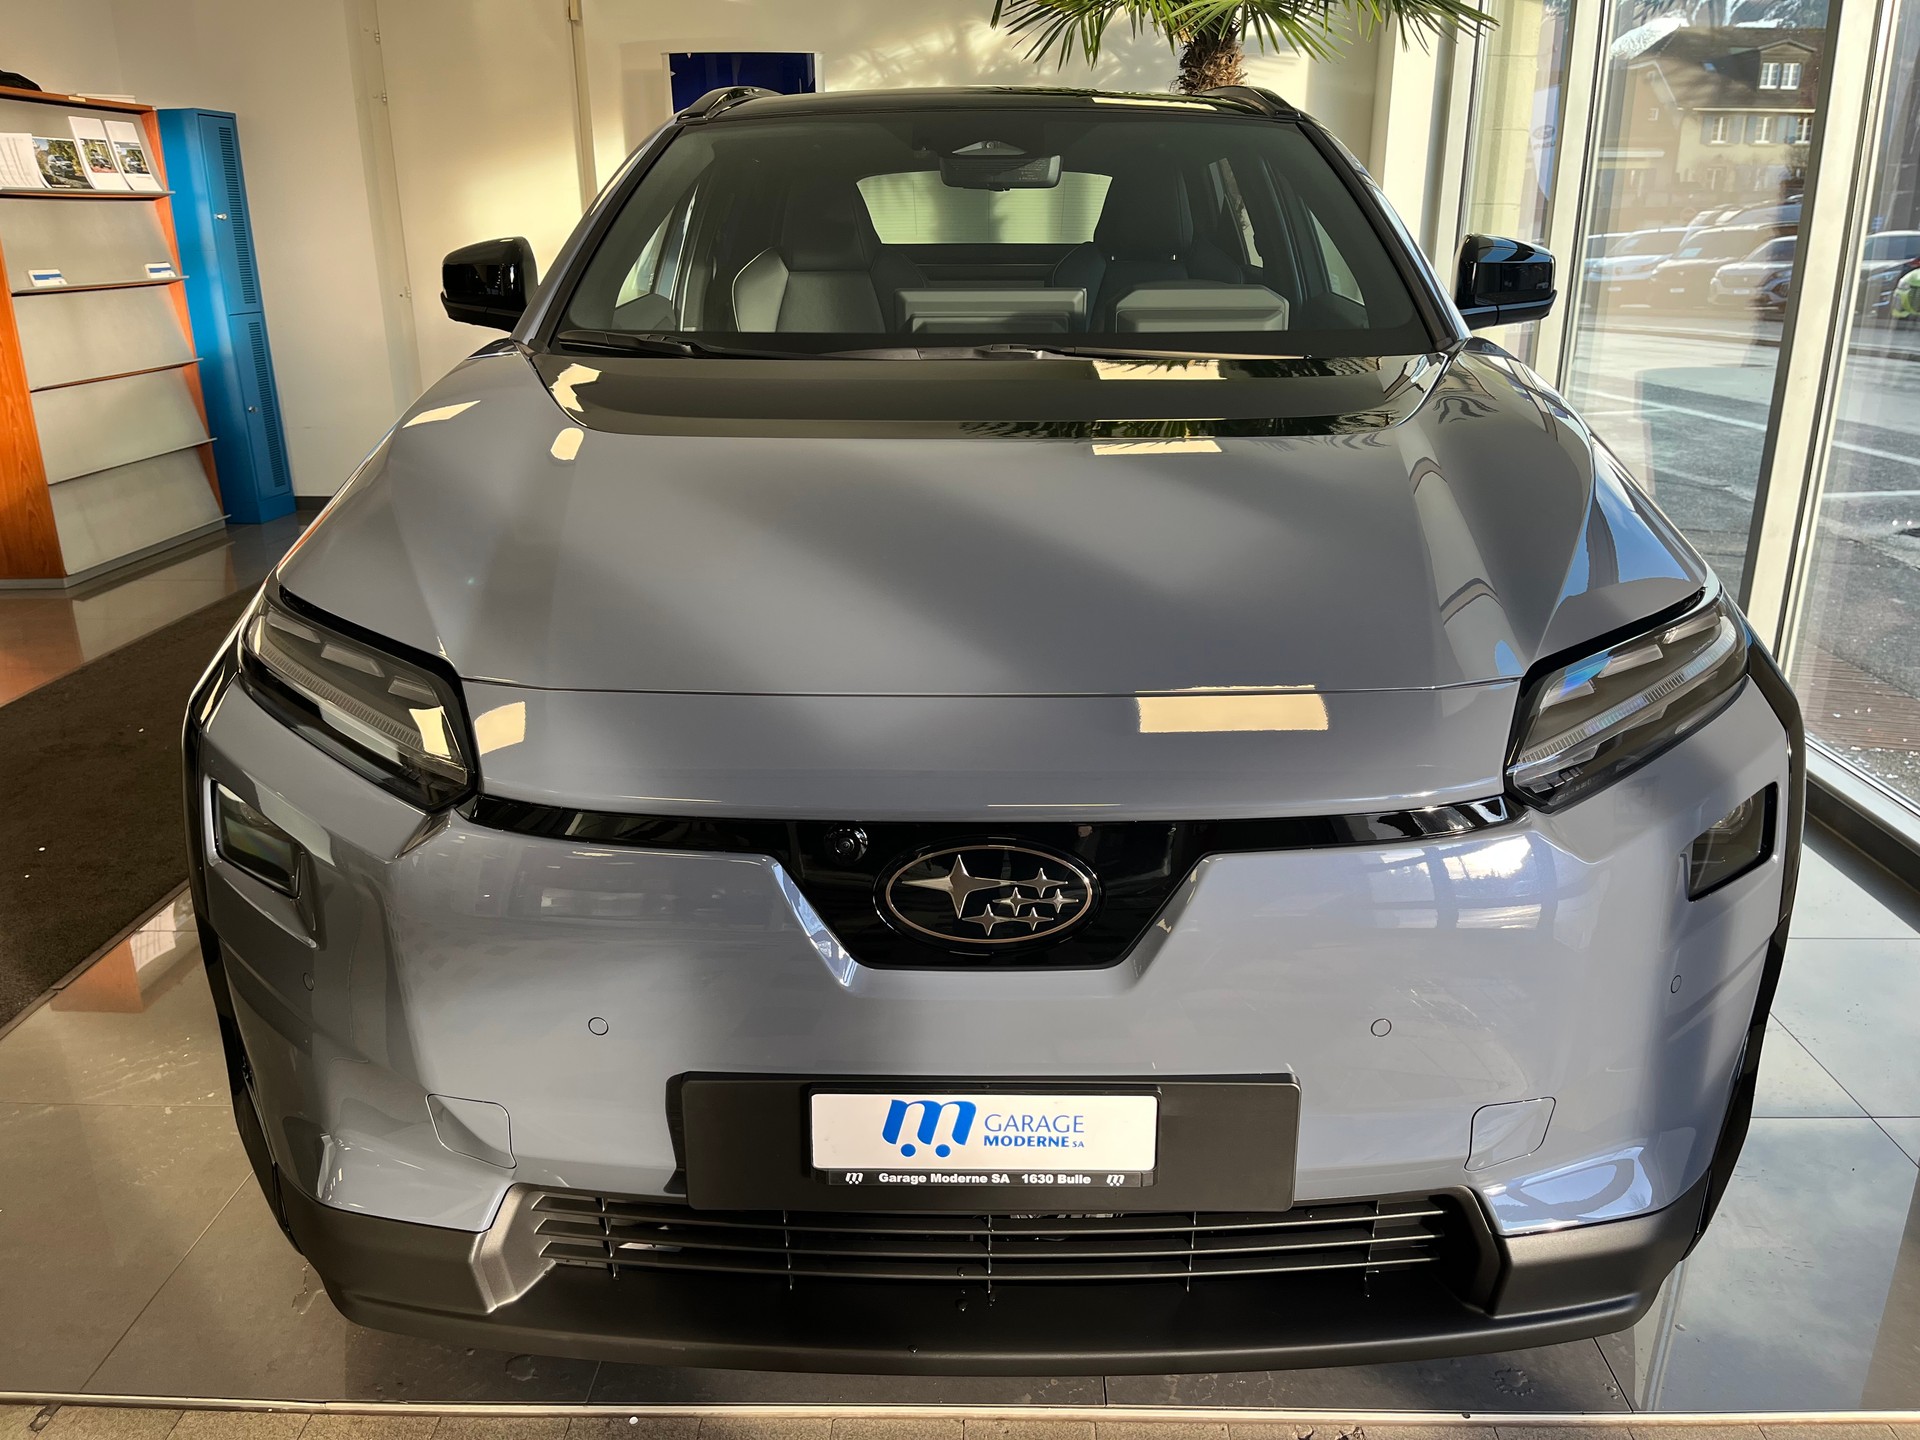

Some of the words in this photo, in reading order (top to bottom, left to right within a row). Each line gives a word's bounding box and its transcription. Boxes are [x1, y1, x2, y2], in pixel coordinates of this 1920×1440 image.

[984, 1113, 1085, 1133] GARAGE
[983, 1135, 1070, 1148] MODERNE
[1071, 1140, 1085, 1148] SA
[878, 1172, 927, 1184] Garage
[930, 1173, 988, 1184] Moderne
[991, 1173, 1011, 1184] SA
[1021, 1173, 1054, 1184] 1630
[1057, 1173, 1092, 1184] Bulle
